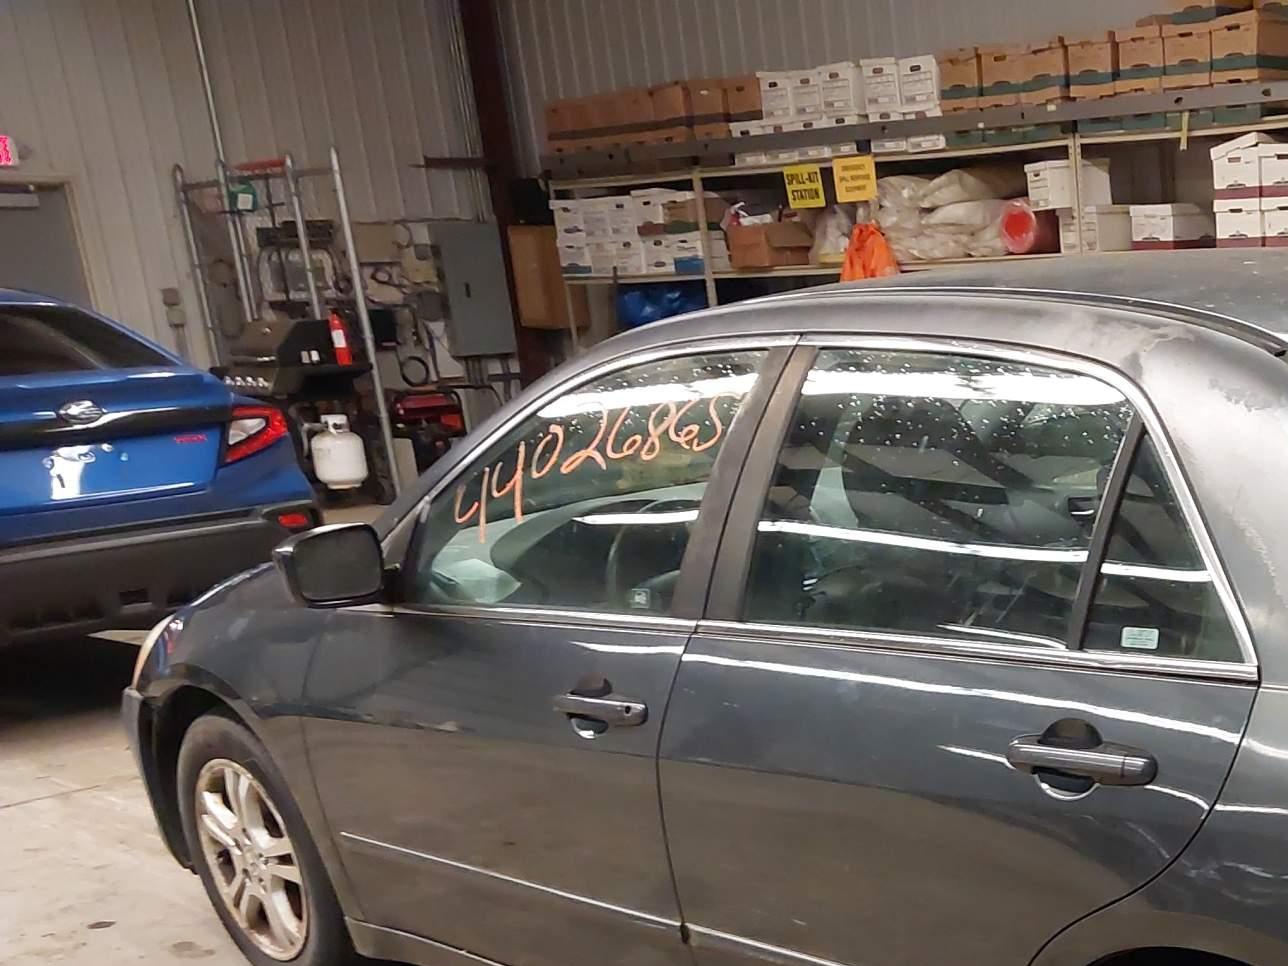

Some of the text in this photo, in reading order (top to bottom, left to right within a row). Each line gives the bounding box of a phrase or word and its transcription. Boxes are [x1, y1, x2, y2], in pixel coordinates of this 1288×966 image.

[786, 172, 819, 185] SPILL-KIT
[791, 188, 820, 201] STATION
[453, 392, 748, 544] 44026865
